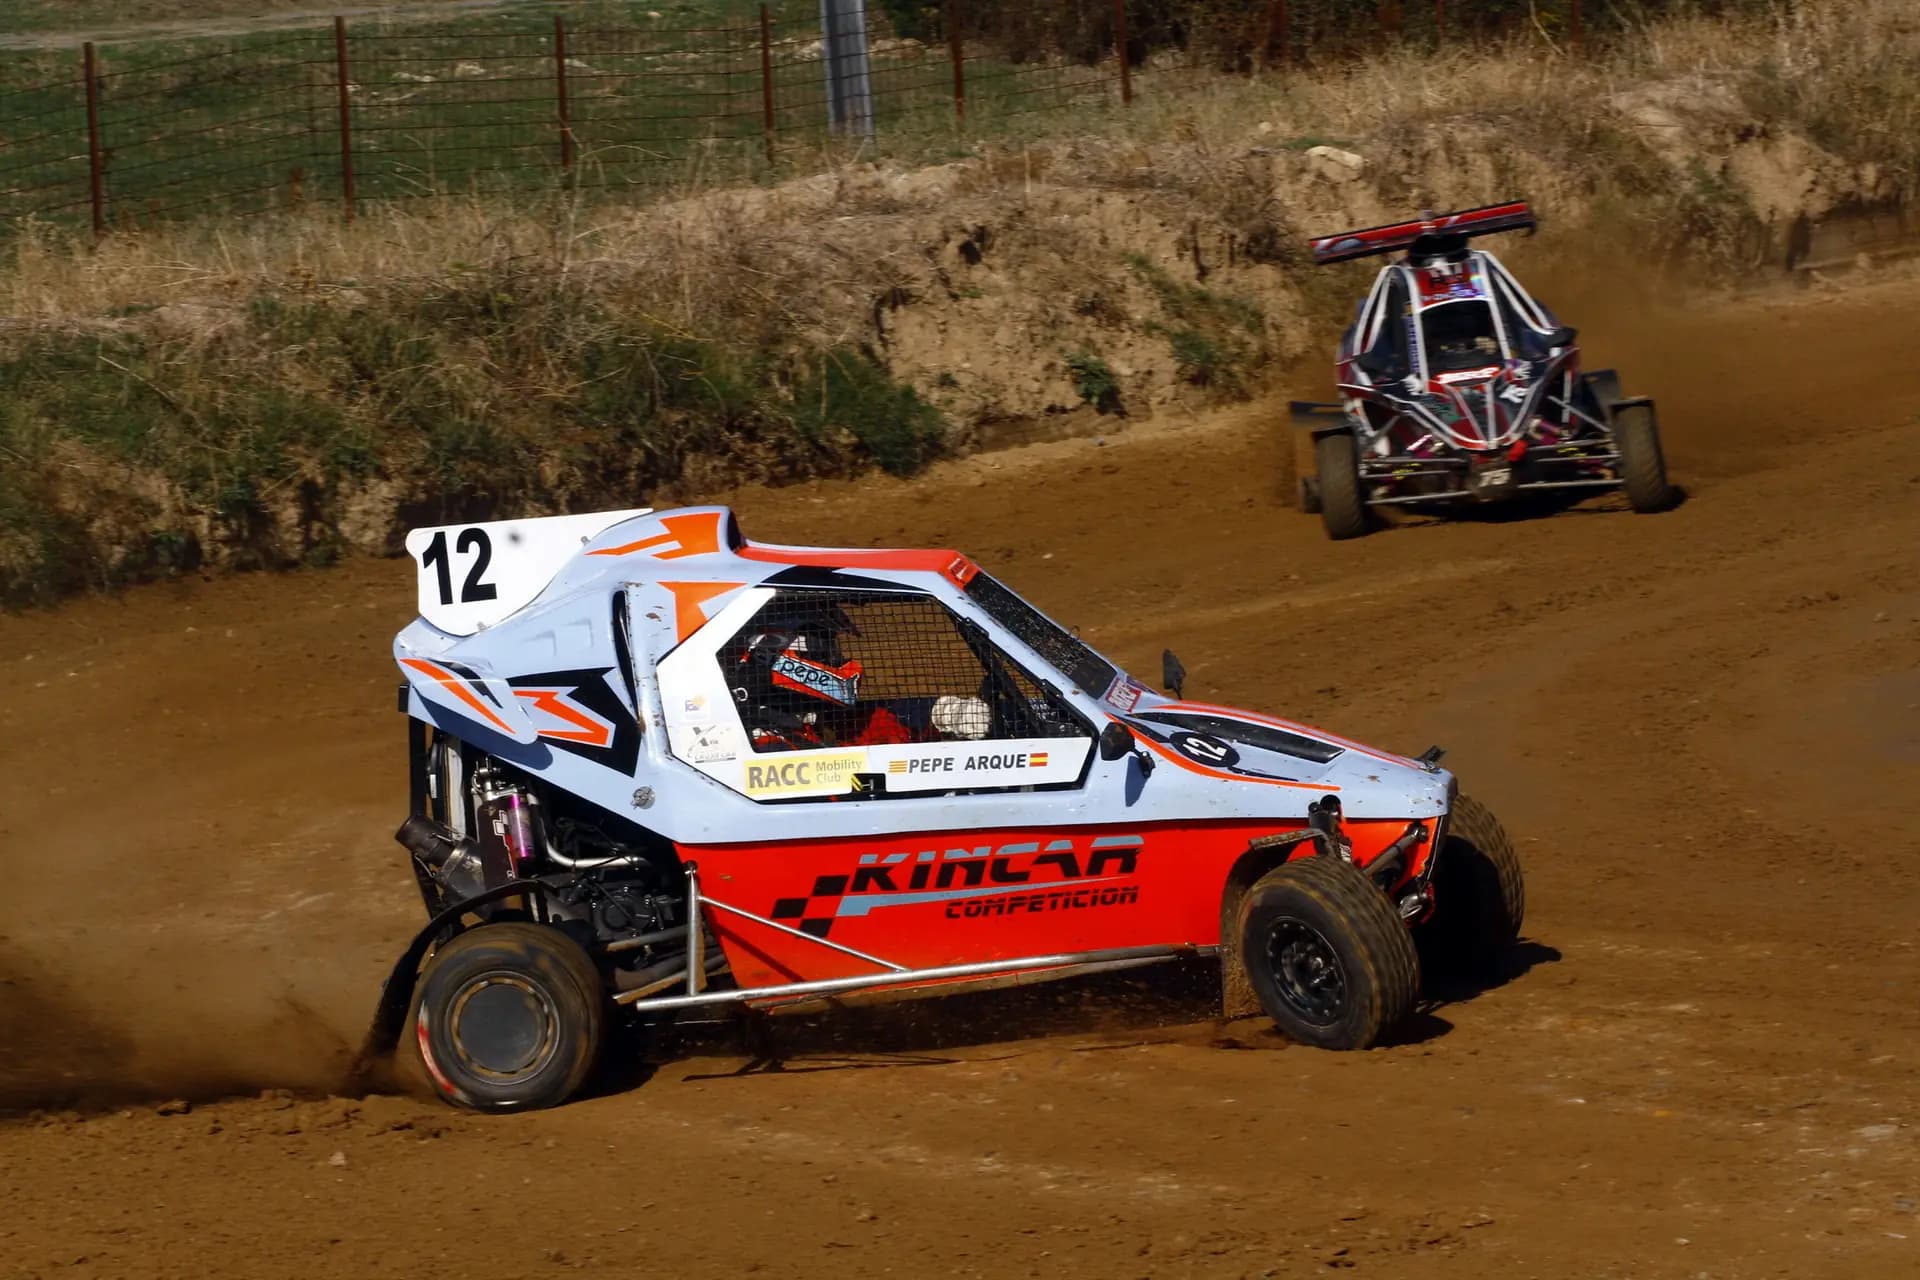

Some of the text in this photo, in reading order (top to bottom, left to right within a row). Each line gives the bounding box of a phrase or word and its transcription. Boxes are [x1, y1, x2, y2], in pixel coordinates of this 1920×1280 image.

[421, 527, 498, 606] 12
[780, 659, 831, 686] pepe
[1182, 737, 1227, 761] 12
[748, 762, 811, 789] RACC
[815, 758, 863, 772] Mobility
[909, 754, 1027, 773] PEPE ARQUE
[816, 773, 841, 784] Club
[850, 835, 1145, 893] KINCAR
[945, 885, 1140, 920] COMPETICION
